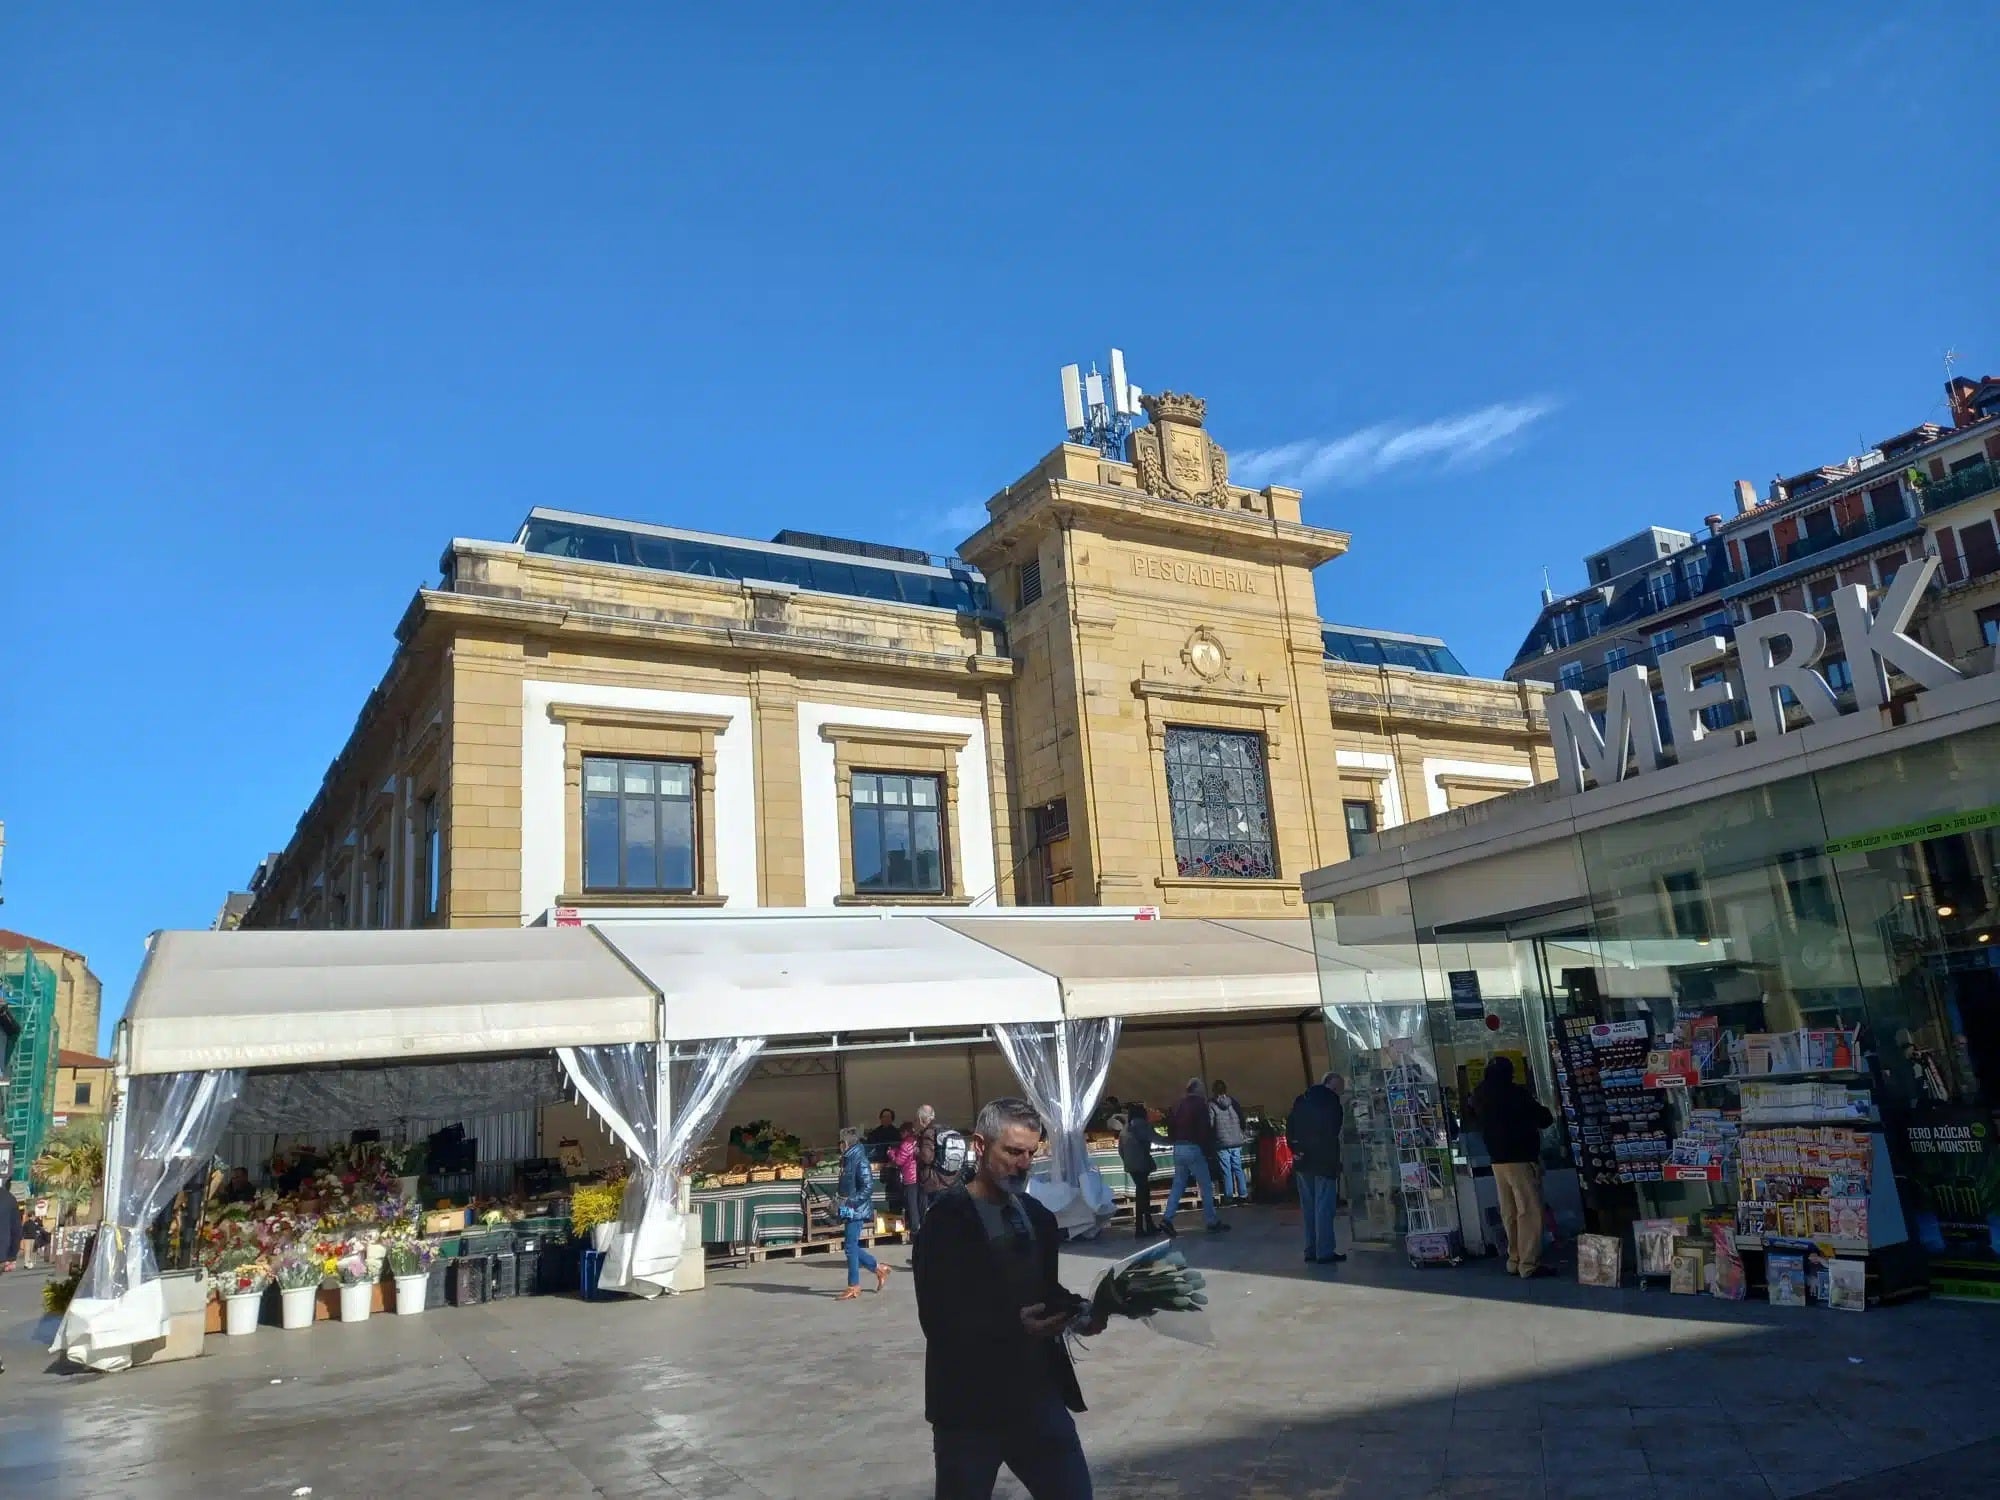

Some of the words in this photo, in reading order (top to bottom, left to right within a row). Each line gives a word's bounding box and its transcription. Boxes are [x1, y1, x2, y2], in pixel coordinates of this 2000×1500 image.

[1132, 554, 1257, 594] PESCADERIA
[1545, 555, 2000, 793] MERK
[1907, 1127, 1932, 1139] ZERO
[1933, 1124, 1971, 1139] AZÚCAR
[1910, 1140, 1936, 1152] 100%
[1936, 1140, 1983, 1152] MONSTER
